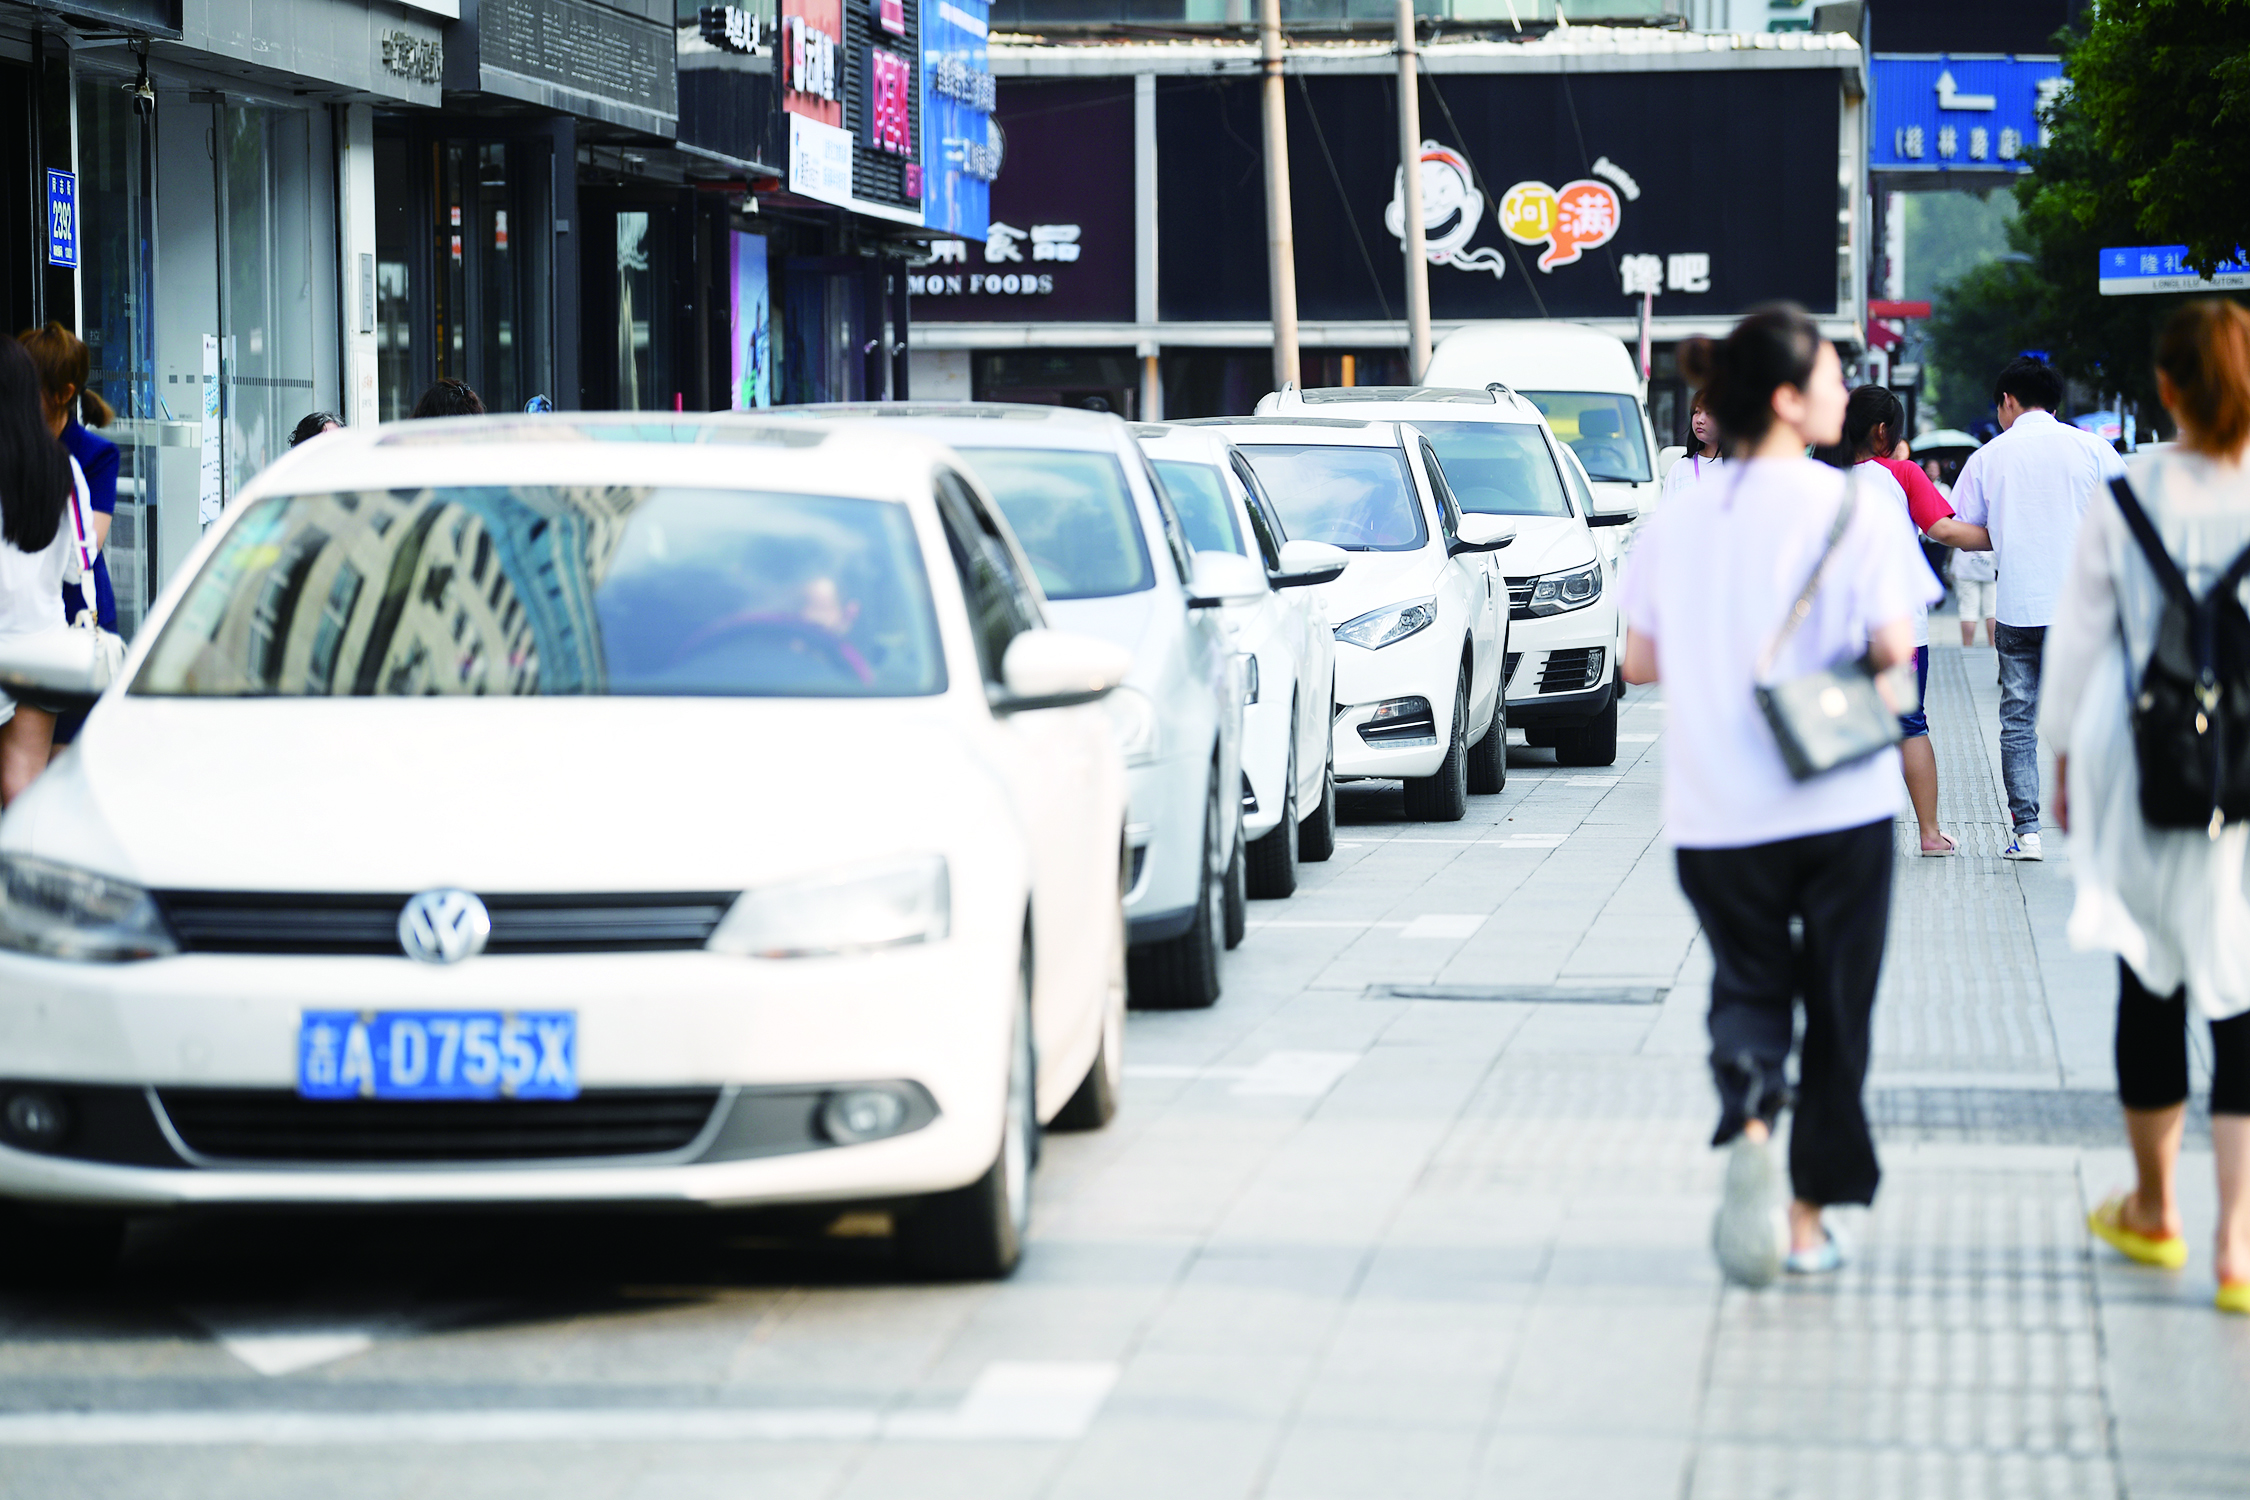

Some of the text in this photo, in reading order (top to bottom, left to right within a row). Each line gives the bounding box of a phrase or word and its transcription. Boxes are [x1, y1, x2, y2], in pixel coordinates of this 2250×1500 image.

[53, 200, 72, 240] 2392
[1506, 189, 1612, 238] 阿满
[887, 273, 1054, 295] MON FOODS
